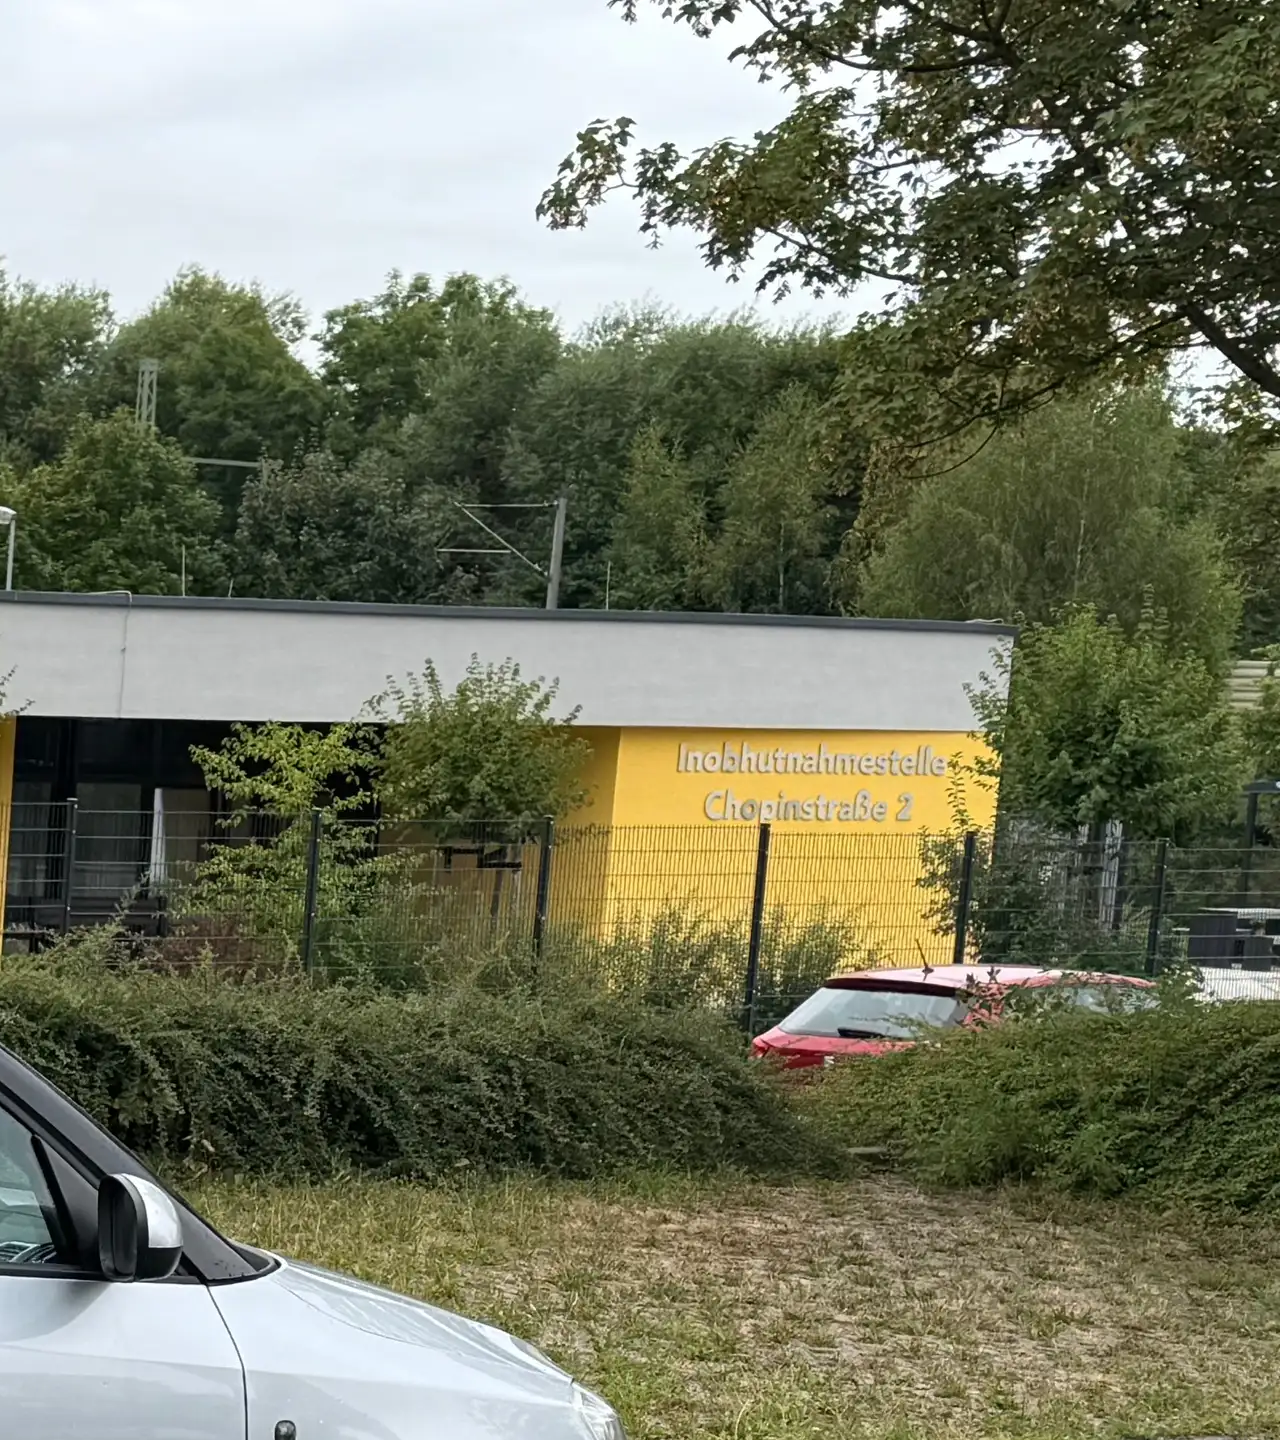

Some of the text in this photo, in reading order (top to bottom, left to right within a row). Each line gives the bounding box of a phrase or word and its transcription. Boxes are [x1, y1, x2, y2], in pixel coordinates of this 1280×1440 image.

[677, 741, 946, 776] Inobhutnahmestelle
[704, 788, 914, 823] Chopinstraße 2
